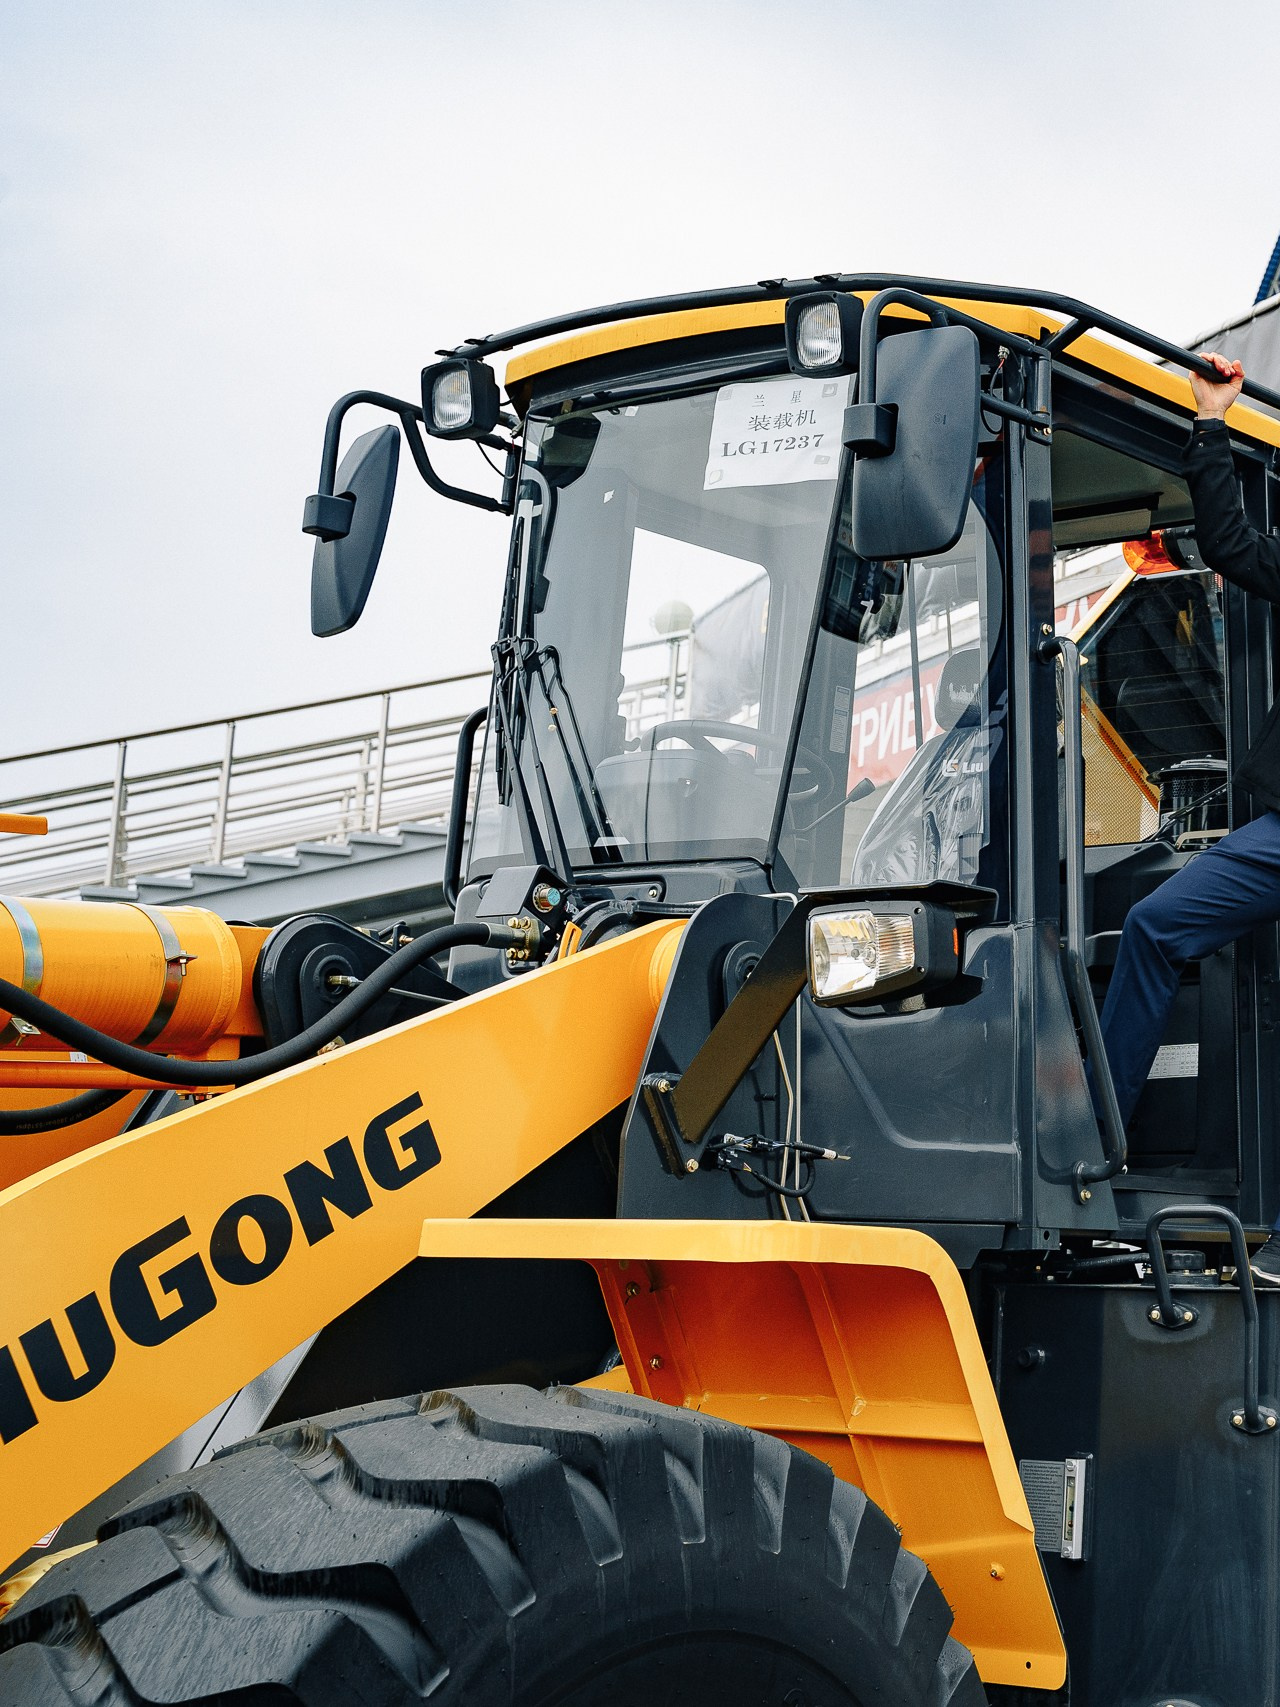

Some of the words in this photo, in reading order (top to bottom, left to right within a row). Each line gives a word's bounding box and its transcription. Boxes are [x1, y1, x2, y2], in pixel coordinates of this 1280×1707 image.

[747, 409, 817, 432] 装载机
[721, 434, 825, 458] LG17237
